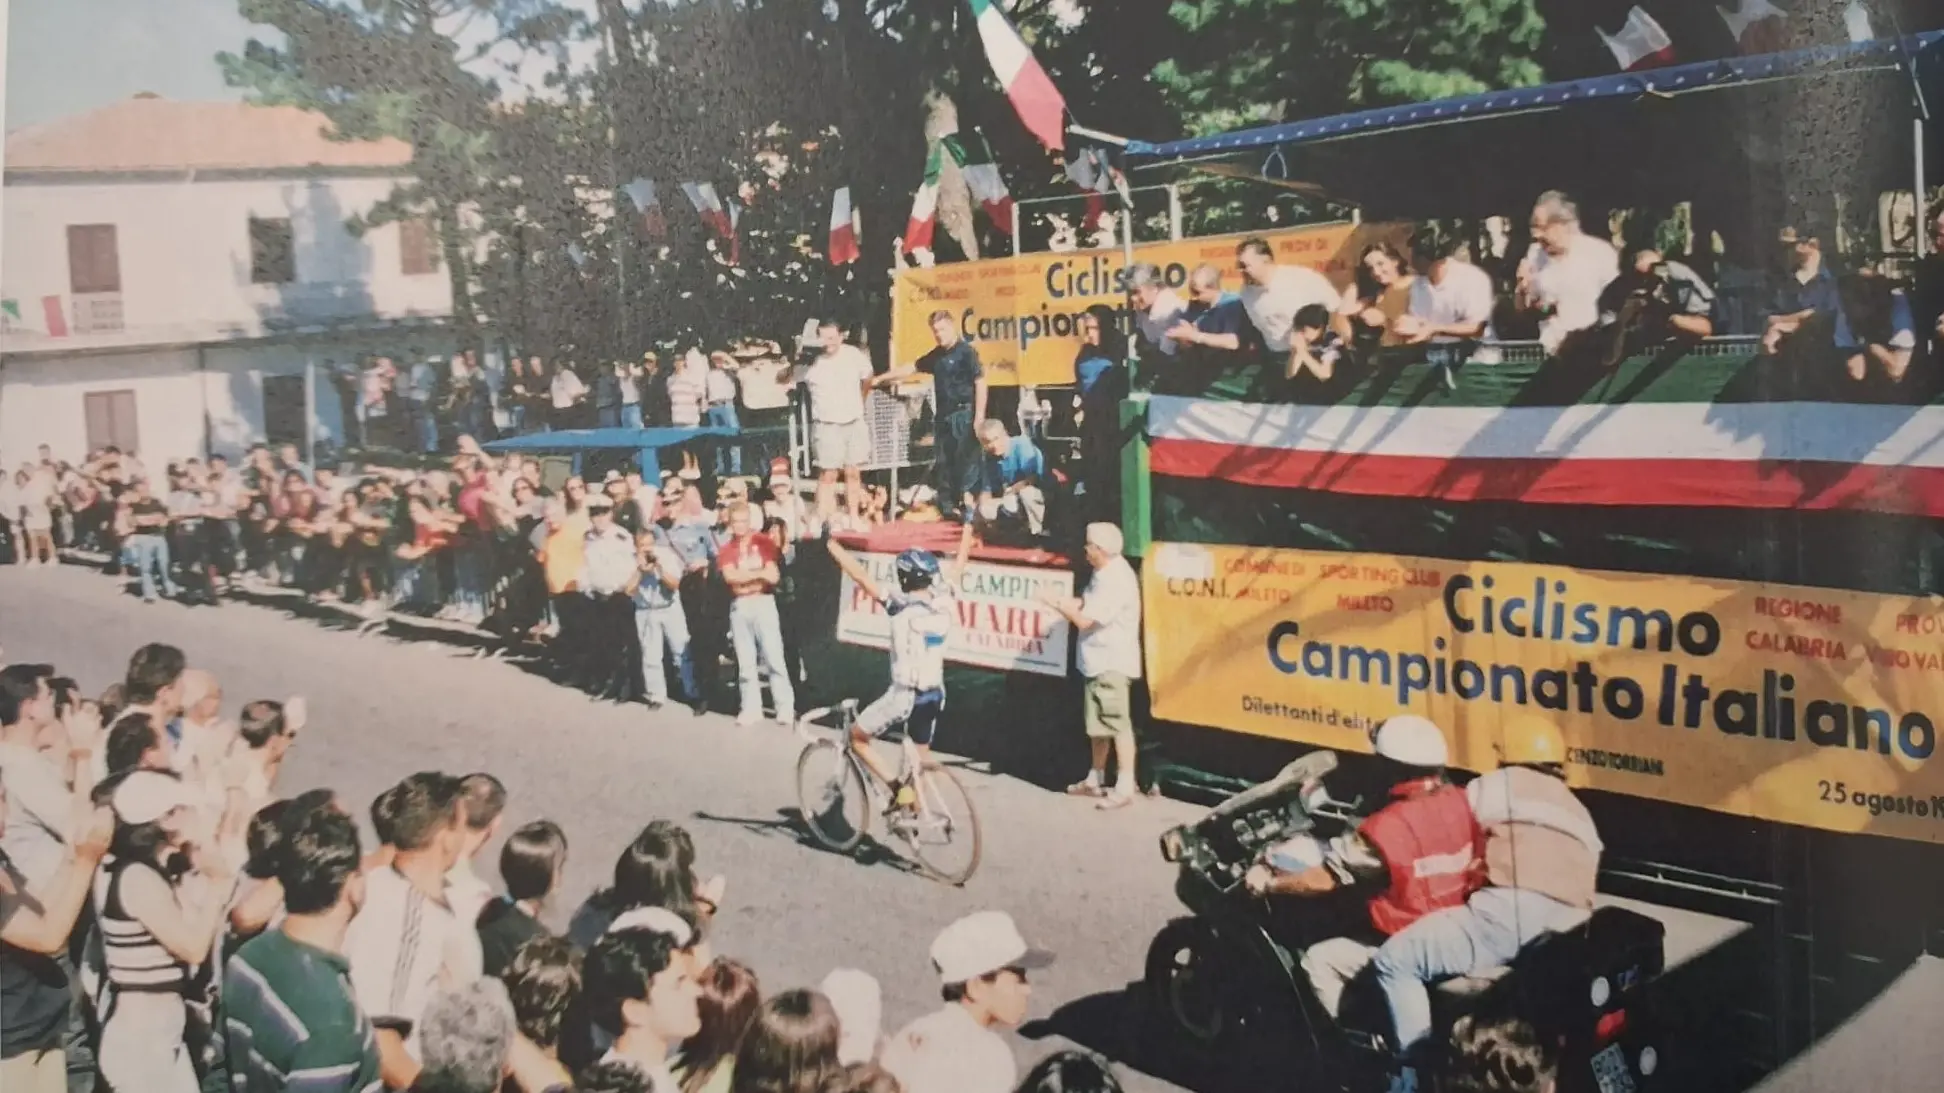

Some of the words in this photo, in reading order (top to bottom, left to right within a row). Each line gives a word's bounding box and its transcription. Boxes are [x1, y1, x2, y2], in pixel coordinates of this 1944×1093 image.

[1442, 572, 1721, 657] Ciclismo
[1754, 595, 1842, 625] REGIONE
[1744, 629, 1847, 661] CALABRIA
[1266, 619, 1645, 721] Campionato
[1656, 662, 1937, 761] Italiano
[1241, 694, 1323, 724] Dilettanti
[1817, 779, 1848, 804] 25
[1851, 790, 1930, 817] agosto
